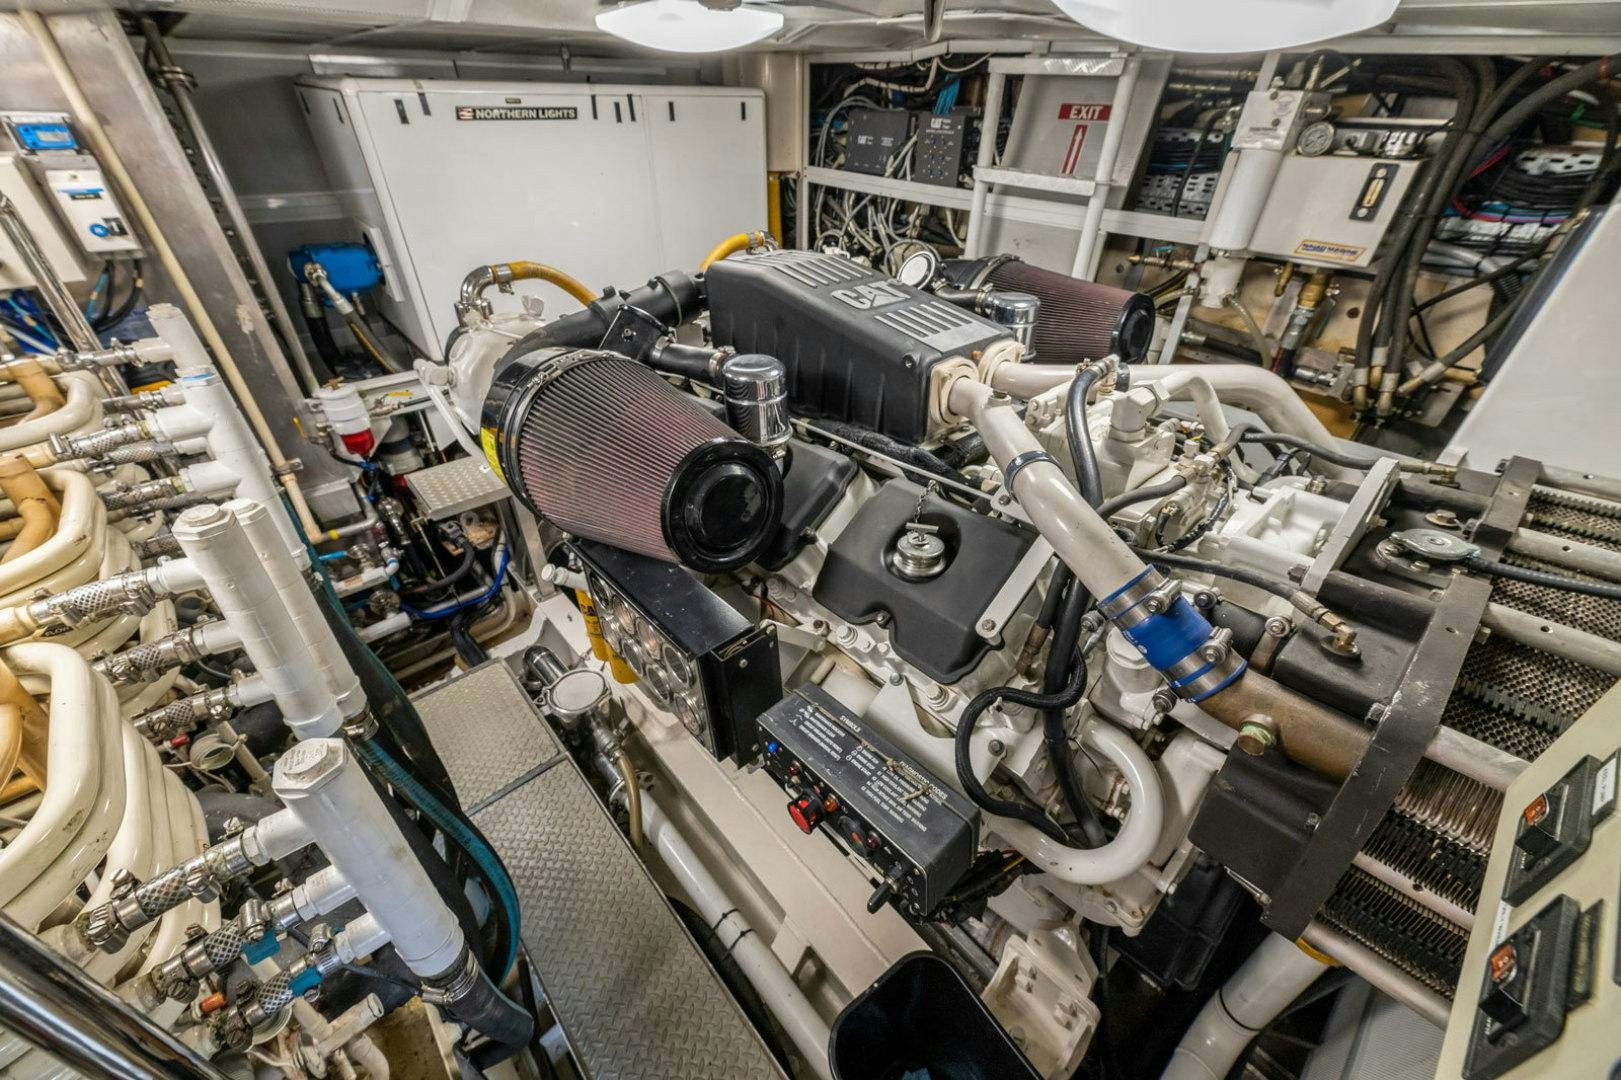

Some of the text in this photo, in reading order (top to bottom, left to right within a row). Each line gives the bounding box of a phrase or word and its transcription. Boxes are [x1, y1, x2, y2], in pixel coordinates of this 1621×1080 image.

[476, 108, 576, 120] NORTHERN LIGHTS
[1069, 105, 1103, 120] EXIT
[830, 280, 911, 310] CAT
[840, 714, 861, 732] SYMBOLS
[899, 760, 929, 784] DIAGNOSTIC
[928, 783, 947, 800] CODES
